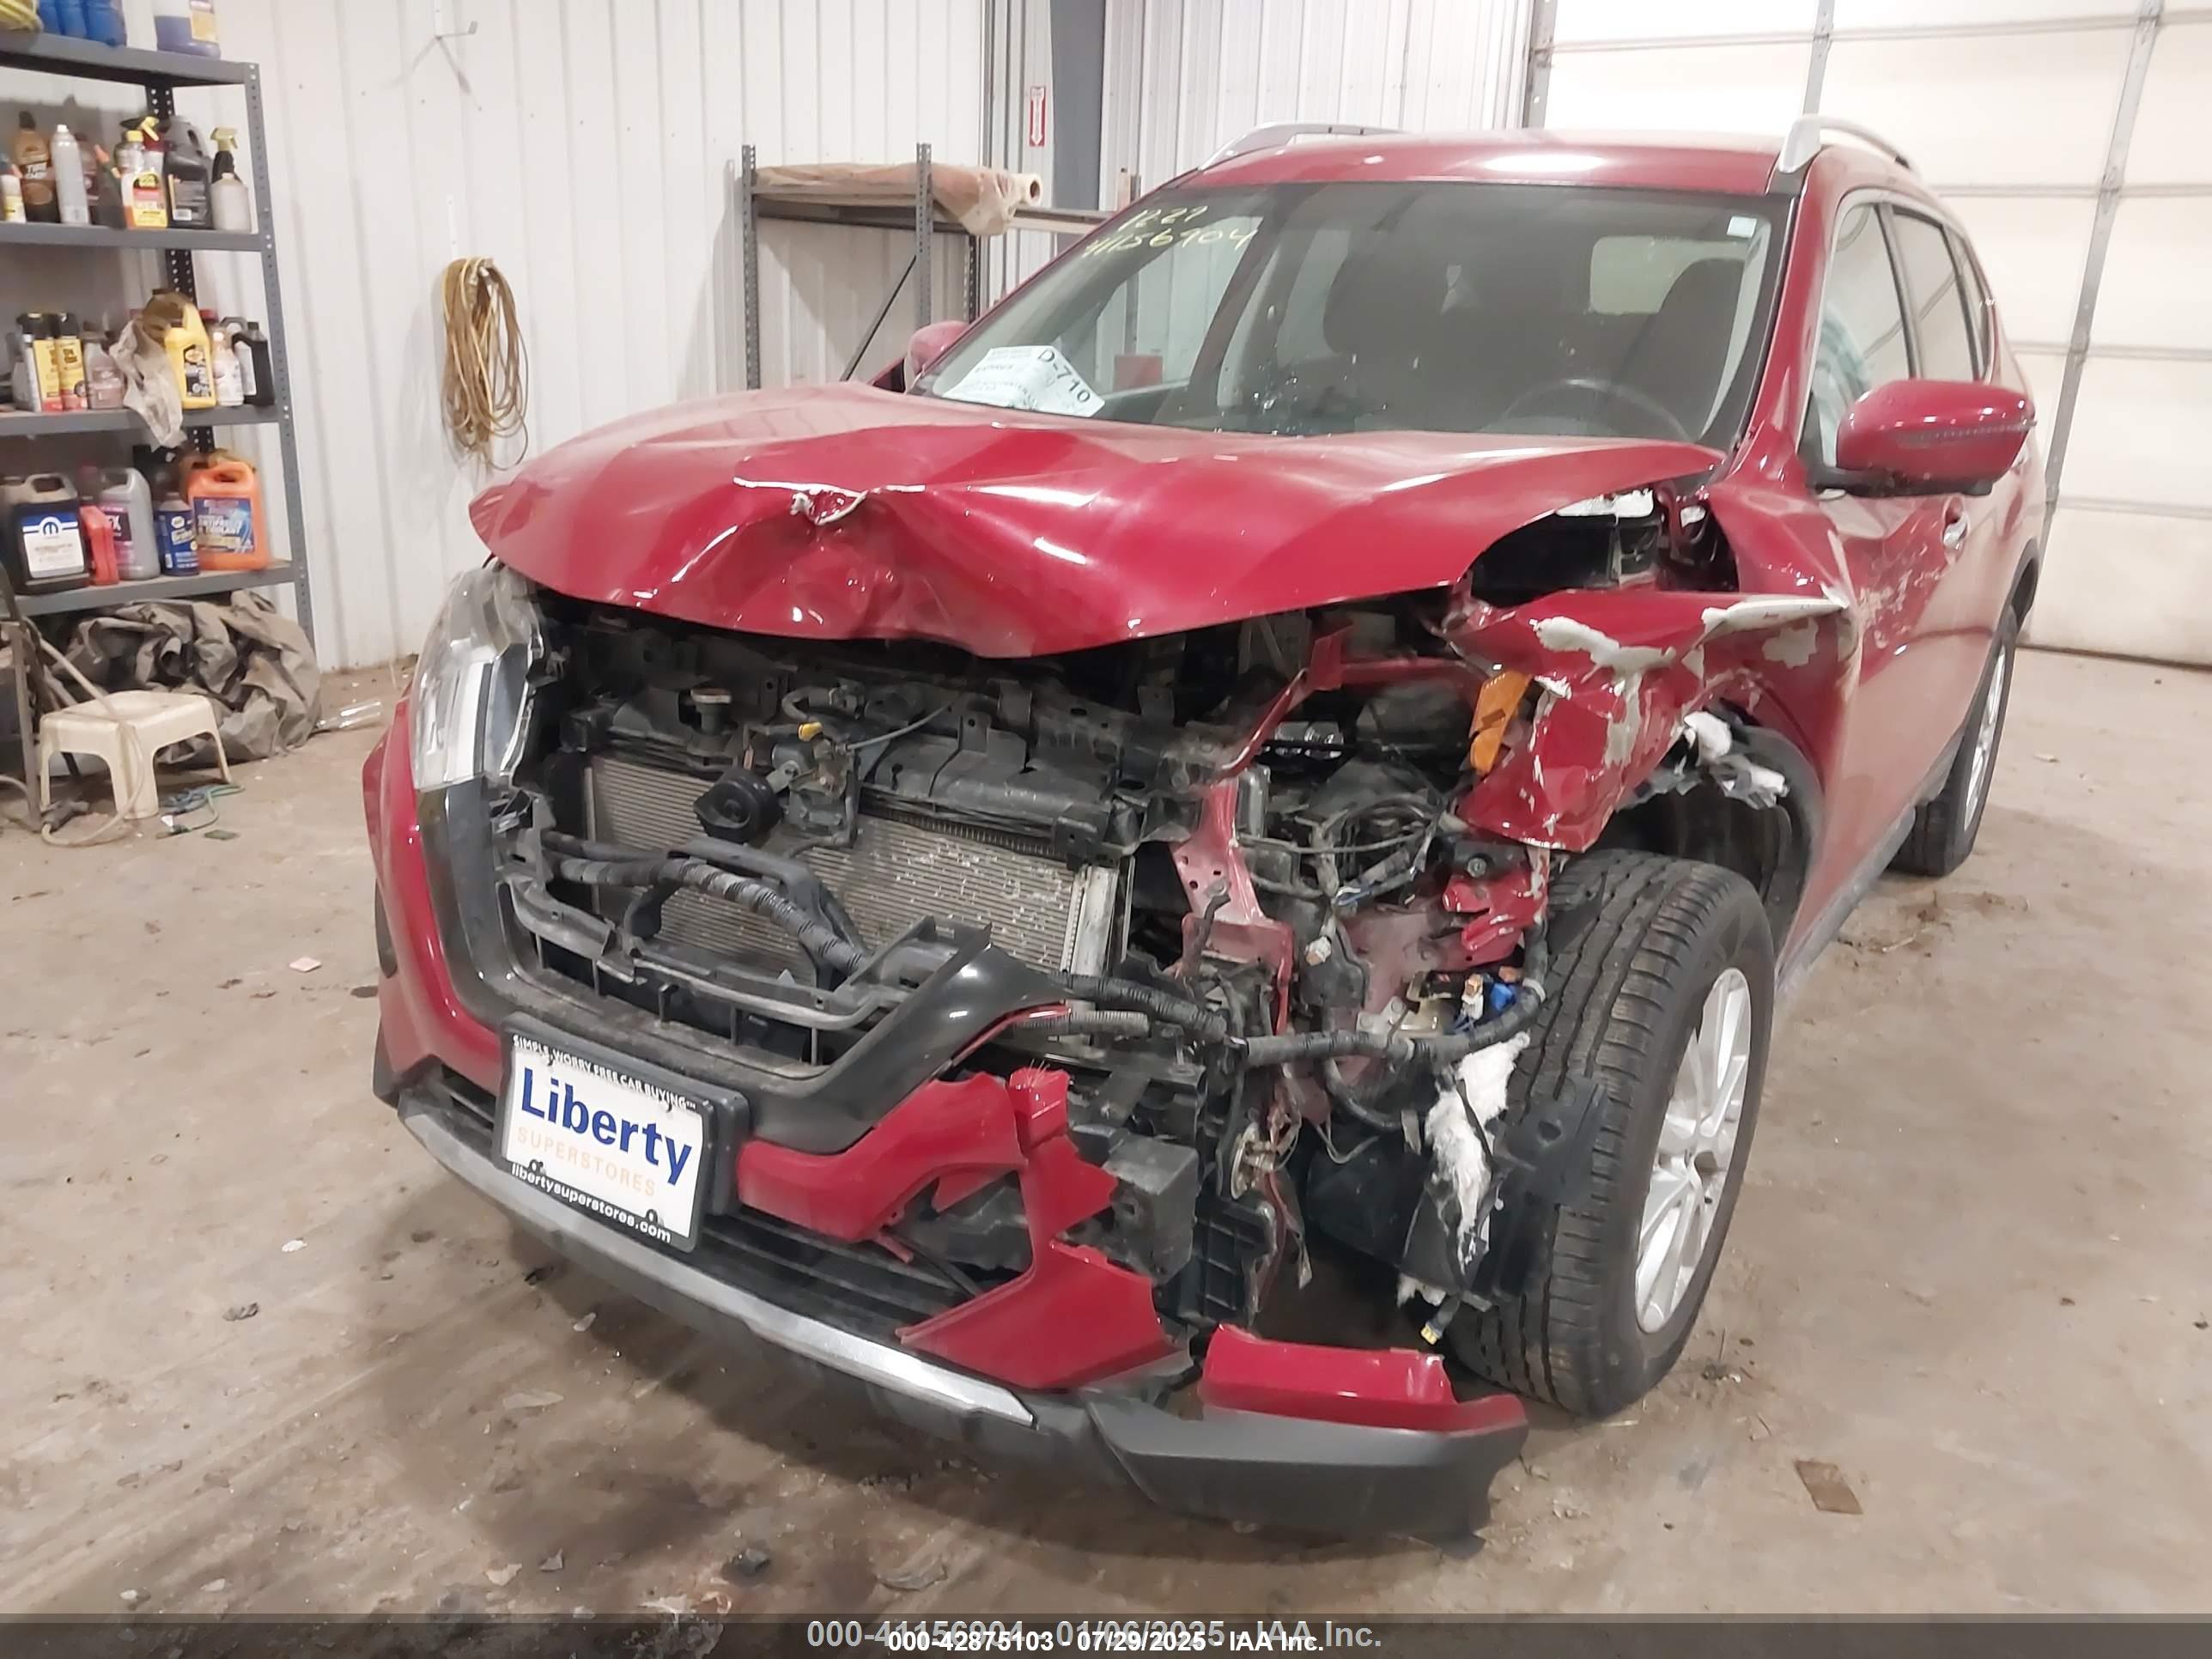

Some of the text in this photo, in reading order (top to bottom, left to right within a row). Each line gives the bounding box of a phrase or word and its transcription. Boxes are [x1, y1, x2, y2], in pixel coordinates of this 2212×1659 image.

[1037, 349, 1091, 404] D-710
[619, 1073, 643, 1091] CAR
[517, 1126, 655, 1197] SUPERSTORES
[521, 1066, 692, 1187] Liberty
[512, 1164, 672, 1244] libertysuperstores.com
